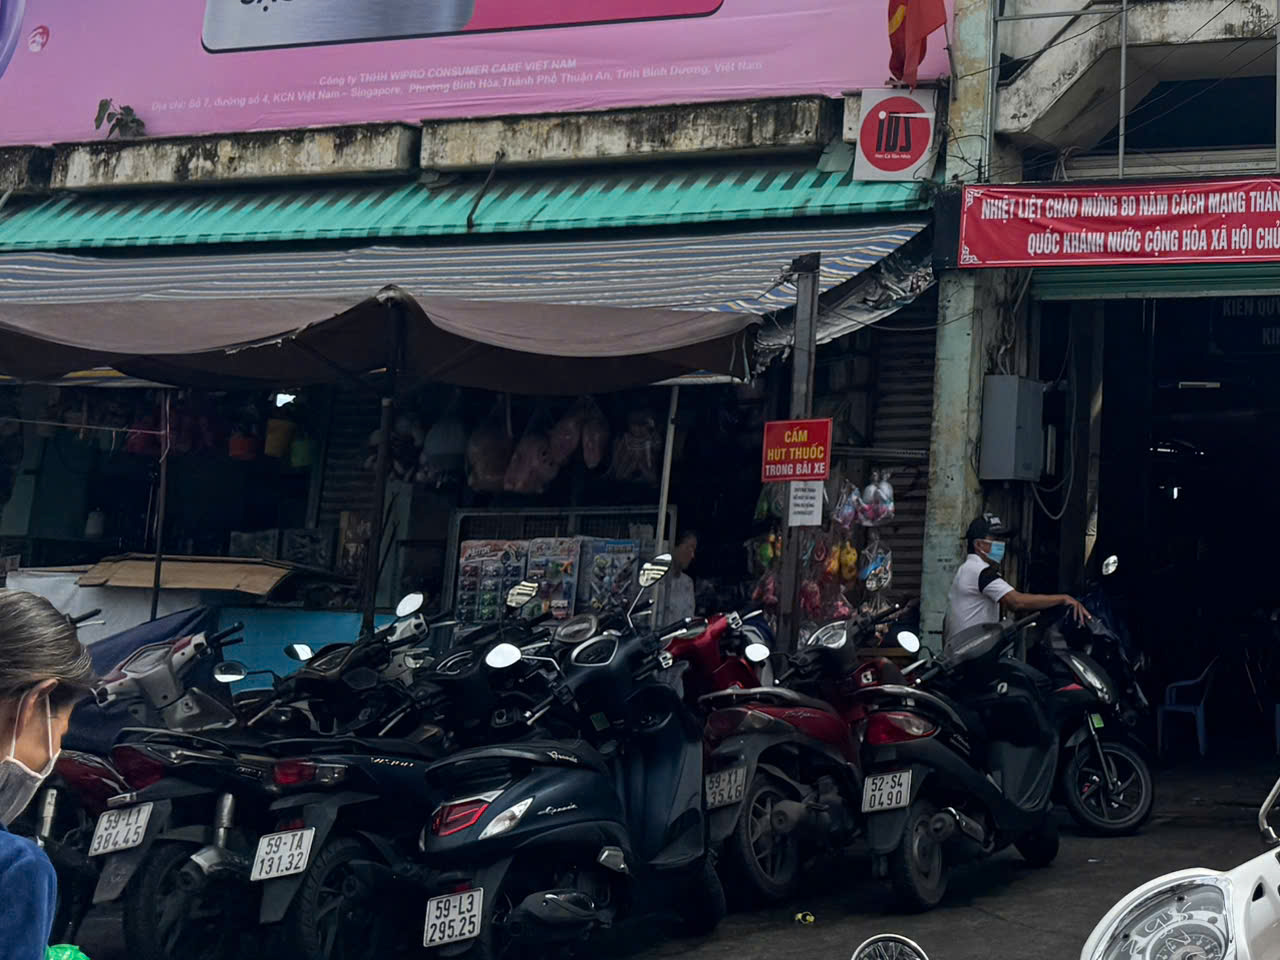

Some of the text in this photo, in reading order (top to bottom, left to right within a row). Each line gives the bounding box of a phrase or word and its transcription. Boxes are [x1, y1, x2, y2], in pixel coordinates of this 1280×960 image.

[360, 71, 388, 82] TNHH
[391, 69, 424, 81] WIPRO
[428, 63, 489, 78] CONSUMER
[492, 61, 522, 73] CARE
[981, 194, 1016, 224] NHIỆT
[1018, 194, 1043, 223] LIỆT
[1046, 193, 1078, 218] CHÀO
[1121, 196, 1137, 217] 80
[1139, 191, 1168, 216] NĂM
[1171, 189, 1205, 215] CÁCH
[1208, 191, 1246, 218] MẠNG
[1027, 225, 1060, 256] QUỐC
[1063, 228, 1104, 253] KHÁNH
[1108, 226, 1142, 252] NƯỚC
[1145, 226, 1179, 256] CỘNG
[1182, 224, 1208, 251] HÒA
[1211, 224, 1228, 250] XÃ
[1231, 223, 1253, 254] HỘI
[784, 426, 808, 443] CẤM
[789, 443, 824, 459] THUỐC
[765, 463, 793, 476] TRONG
[813, 462, 825, 474] XE
[871, 774, 904, 793] 52-S4
[869, 790, 901, 809] 0490
[104, 810, 141, 831] 59-L1
[93, 826, 142, 853] 384.45
[265, 832, 305, 855] 59-TA
[258, 851, 304, 876] 131.32
[435, 894, 474, 920] 59-L3
[429, 914, 477, 943] 295.25
